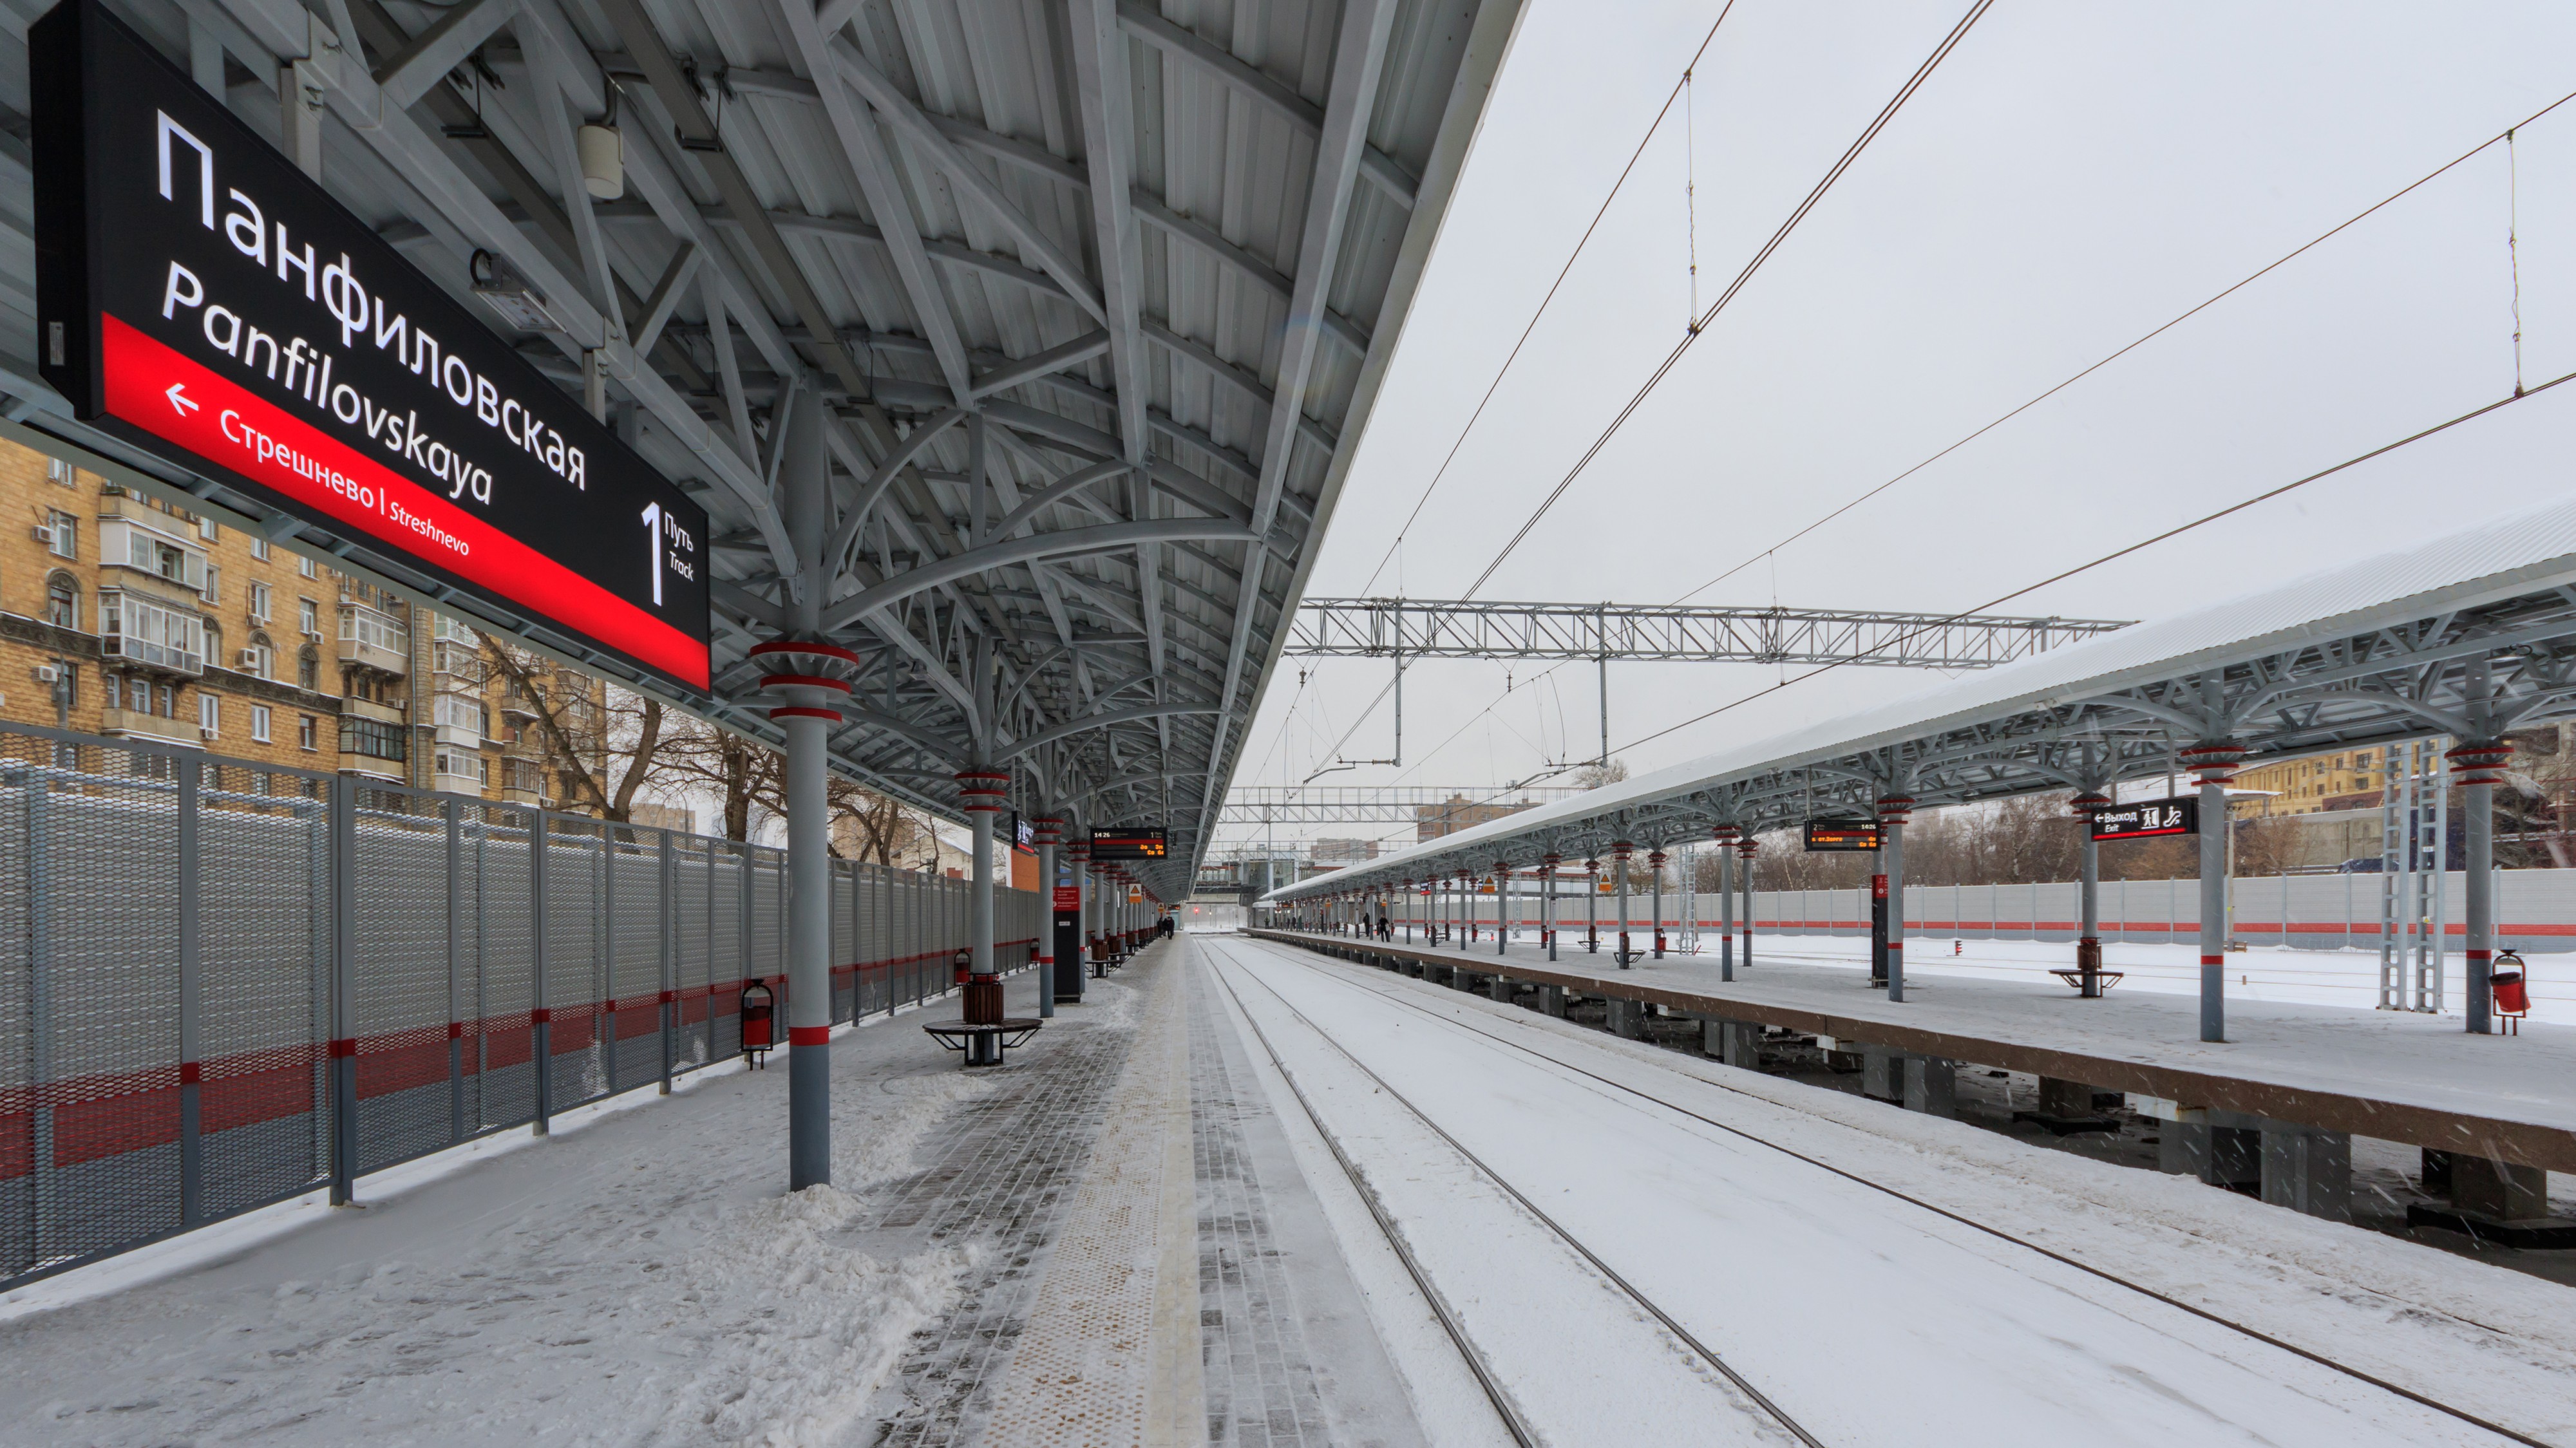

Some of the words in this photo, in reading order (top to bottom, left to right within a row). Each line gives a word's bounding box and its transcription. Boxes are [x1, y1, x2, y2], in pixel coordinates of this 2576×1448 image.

[157, 109, 586, 491] Панфиловская
[162, 259, 493, 506] Panfilovskaya
[220, 409, 374, 509] Стрешнево
[390, 502, 469, 556] Streshnevo
[641, 502, 662, 606] 1
[665, 511, 694, 552] Путь
[669, 550, 694, 581] Track
[2104, 812, 2137, 823] Выход
[2104, 824, 2120, 833] Exit
